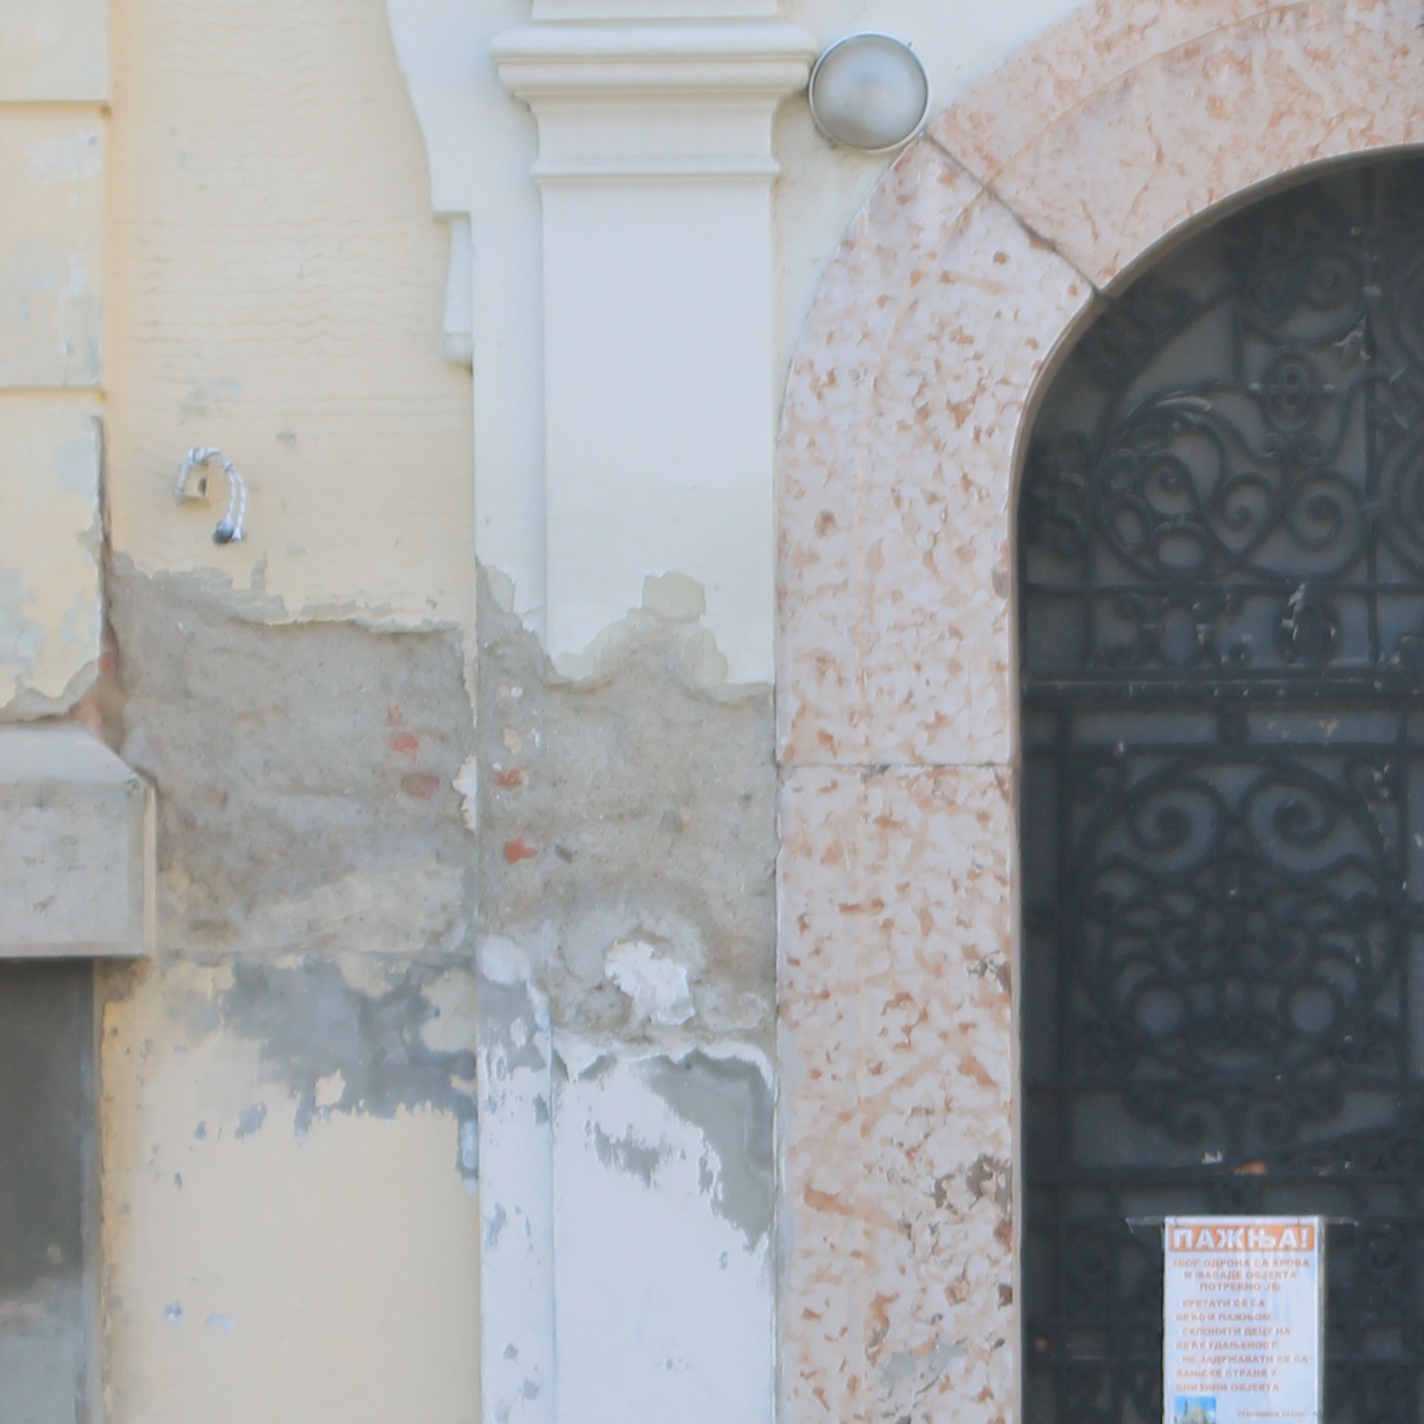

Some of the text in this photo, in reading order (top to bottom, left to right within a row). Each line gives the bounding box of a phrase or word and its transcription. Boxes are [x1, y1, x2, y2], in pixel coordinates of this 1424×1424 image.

[1173, 1227, 1308, 1249] ПАЖЊА!
[1273, 1259, 1309, 1267] КРОВА
[1246, 1271, 1297, 1279] ОБЈЕКТА
[1200, 1283, 1261, 1291] ПОТРЕБНО
[1182, 1327, 1241, 1335] СКЛОНИТИ
[1276, 1327, 1291, 1335] НА
[1231, 1383, 1279, 1391] ОБЈЕКТА
